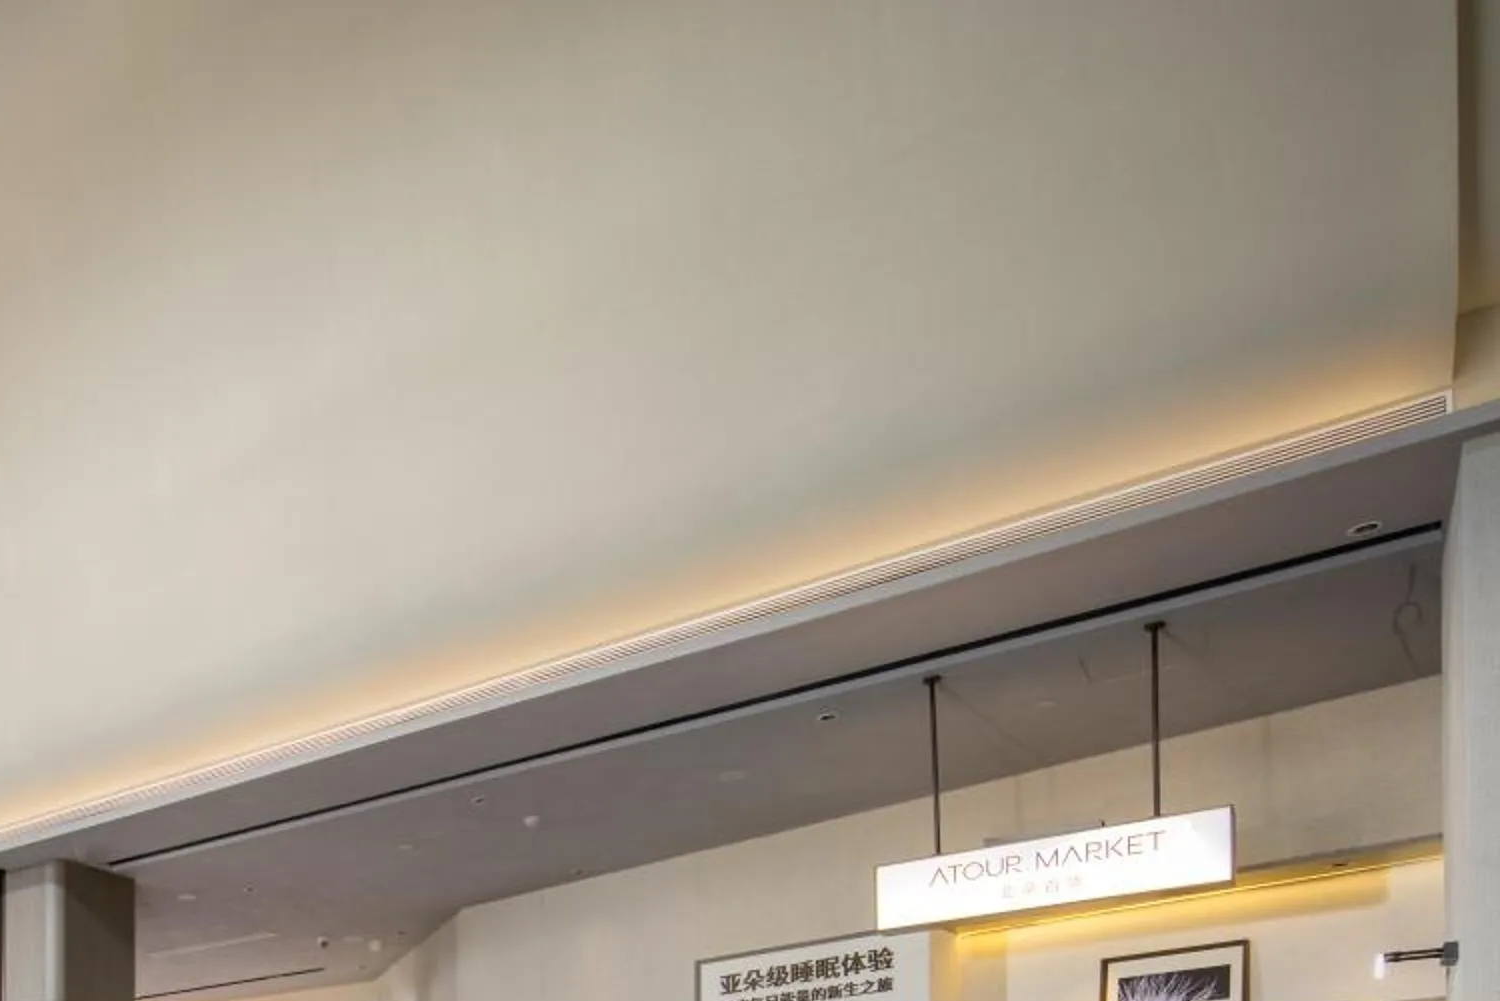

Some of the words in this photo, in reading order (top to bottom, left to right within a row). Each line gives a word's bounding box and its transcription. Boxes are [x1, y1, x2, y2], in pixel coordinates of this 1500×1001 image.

[928, 855, 1024, 888] ATOUR
[1035, 829, 1167, 871] MARKET
[720, 947, 894, 995] 亚朵级睡眠体验
